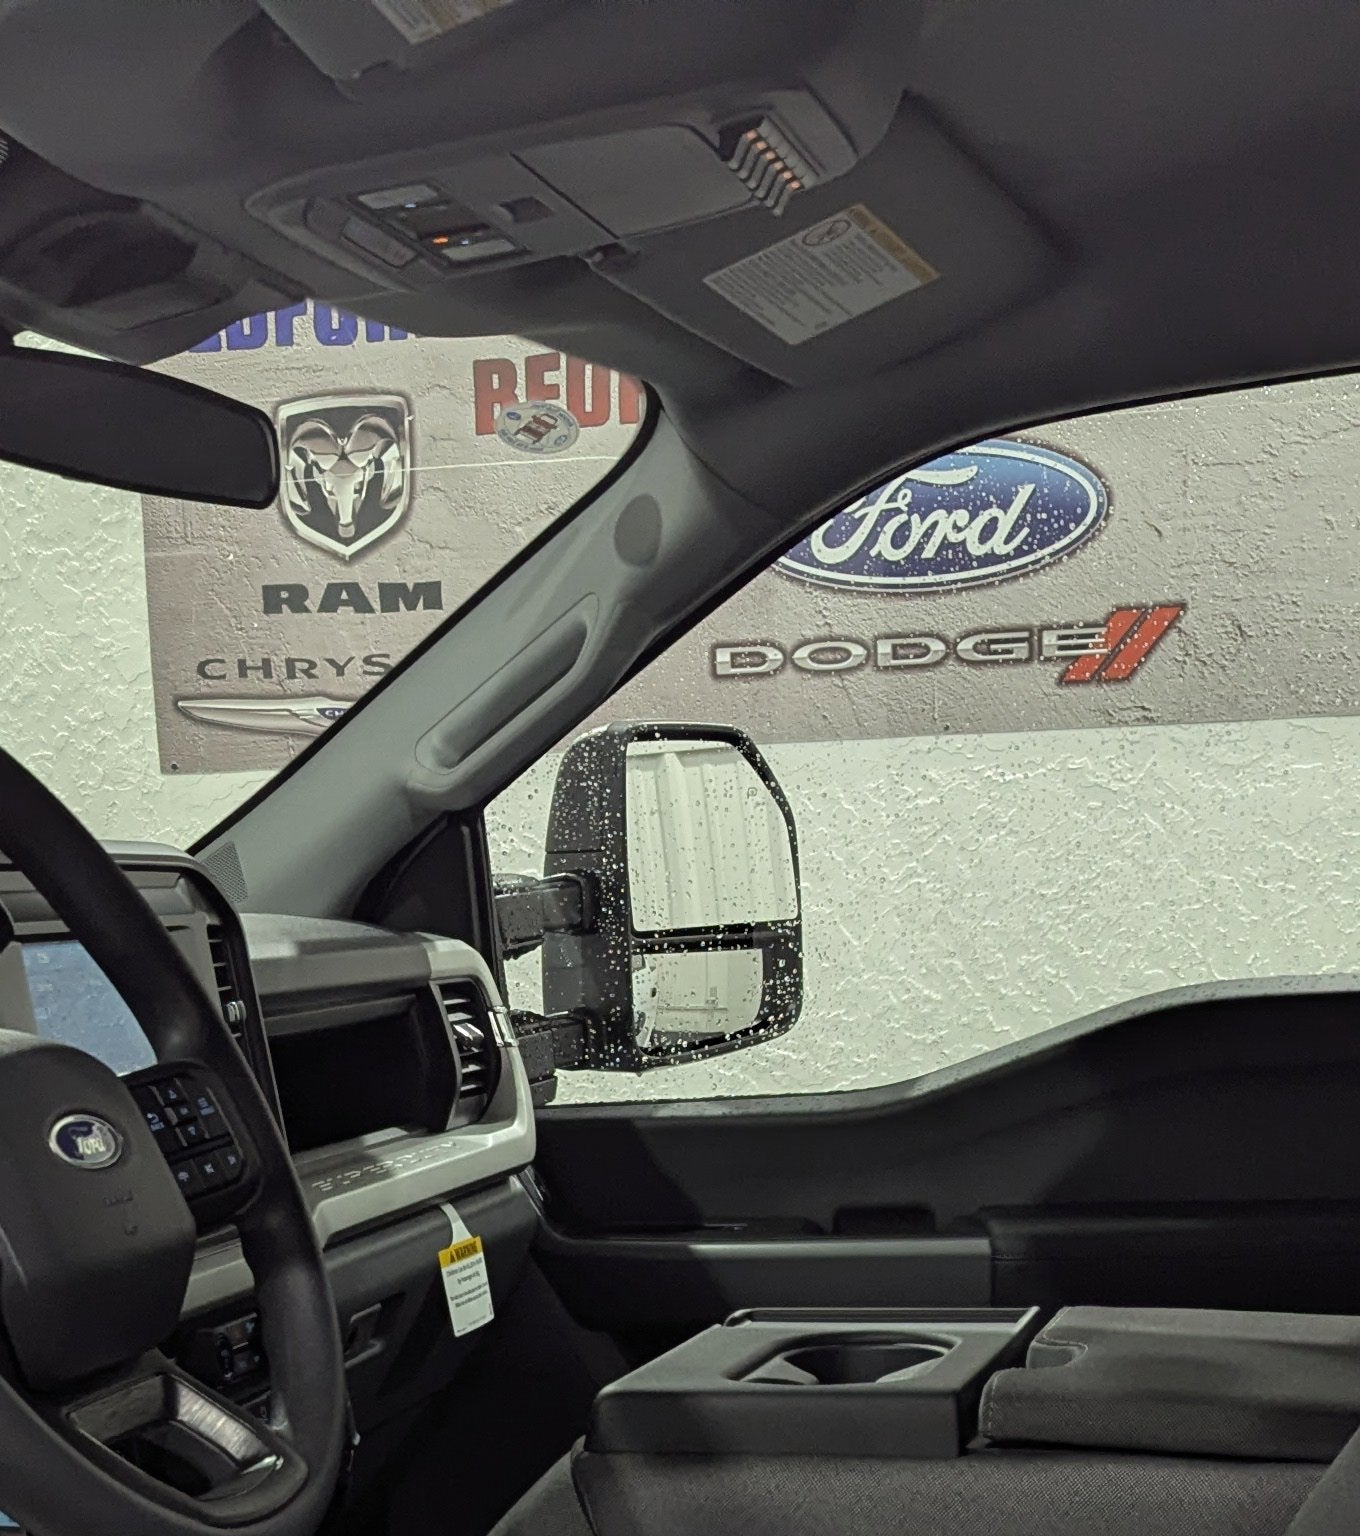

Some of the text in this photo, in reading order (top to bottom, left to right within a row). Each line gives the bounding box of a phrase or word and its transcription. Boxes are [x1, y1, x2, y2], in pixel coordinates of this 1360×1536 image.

[811, 465, 1035, 564] Ford
[262, 580, 443, 614] RAM
[197, 653, 394, 680] CHRYS
[716, 627, 1108, 675] DODGE
